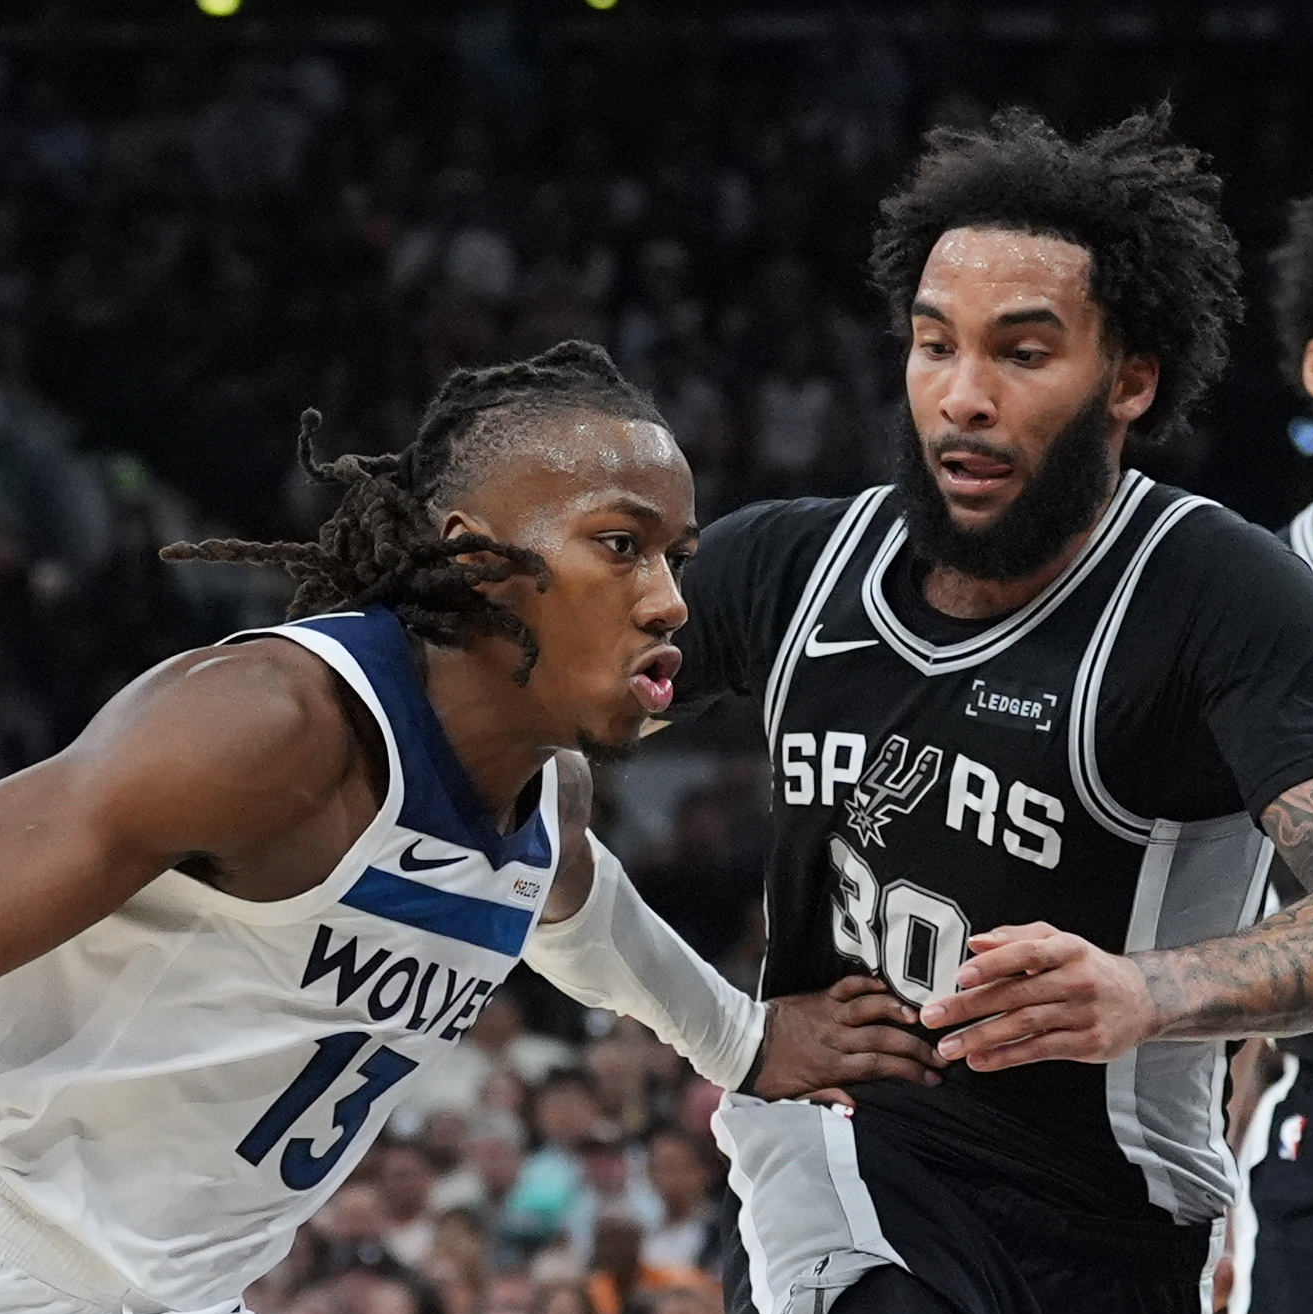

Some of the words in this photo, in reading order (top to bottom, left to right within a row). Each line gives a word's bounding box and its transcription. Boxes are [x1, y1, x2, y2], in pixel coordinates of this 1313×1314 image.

[976, 688, 1043, 721] LEDGER
[782, 731, 1066, 870] SPURS
[301, 924, 502, 1041] WOLVE
[829, 833, 971, 1008] 30
[236, 1031, 419, 1191] 13
